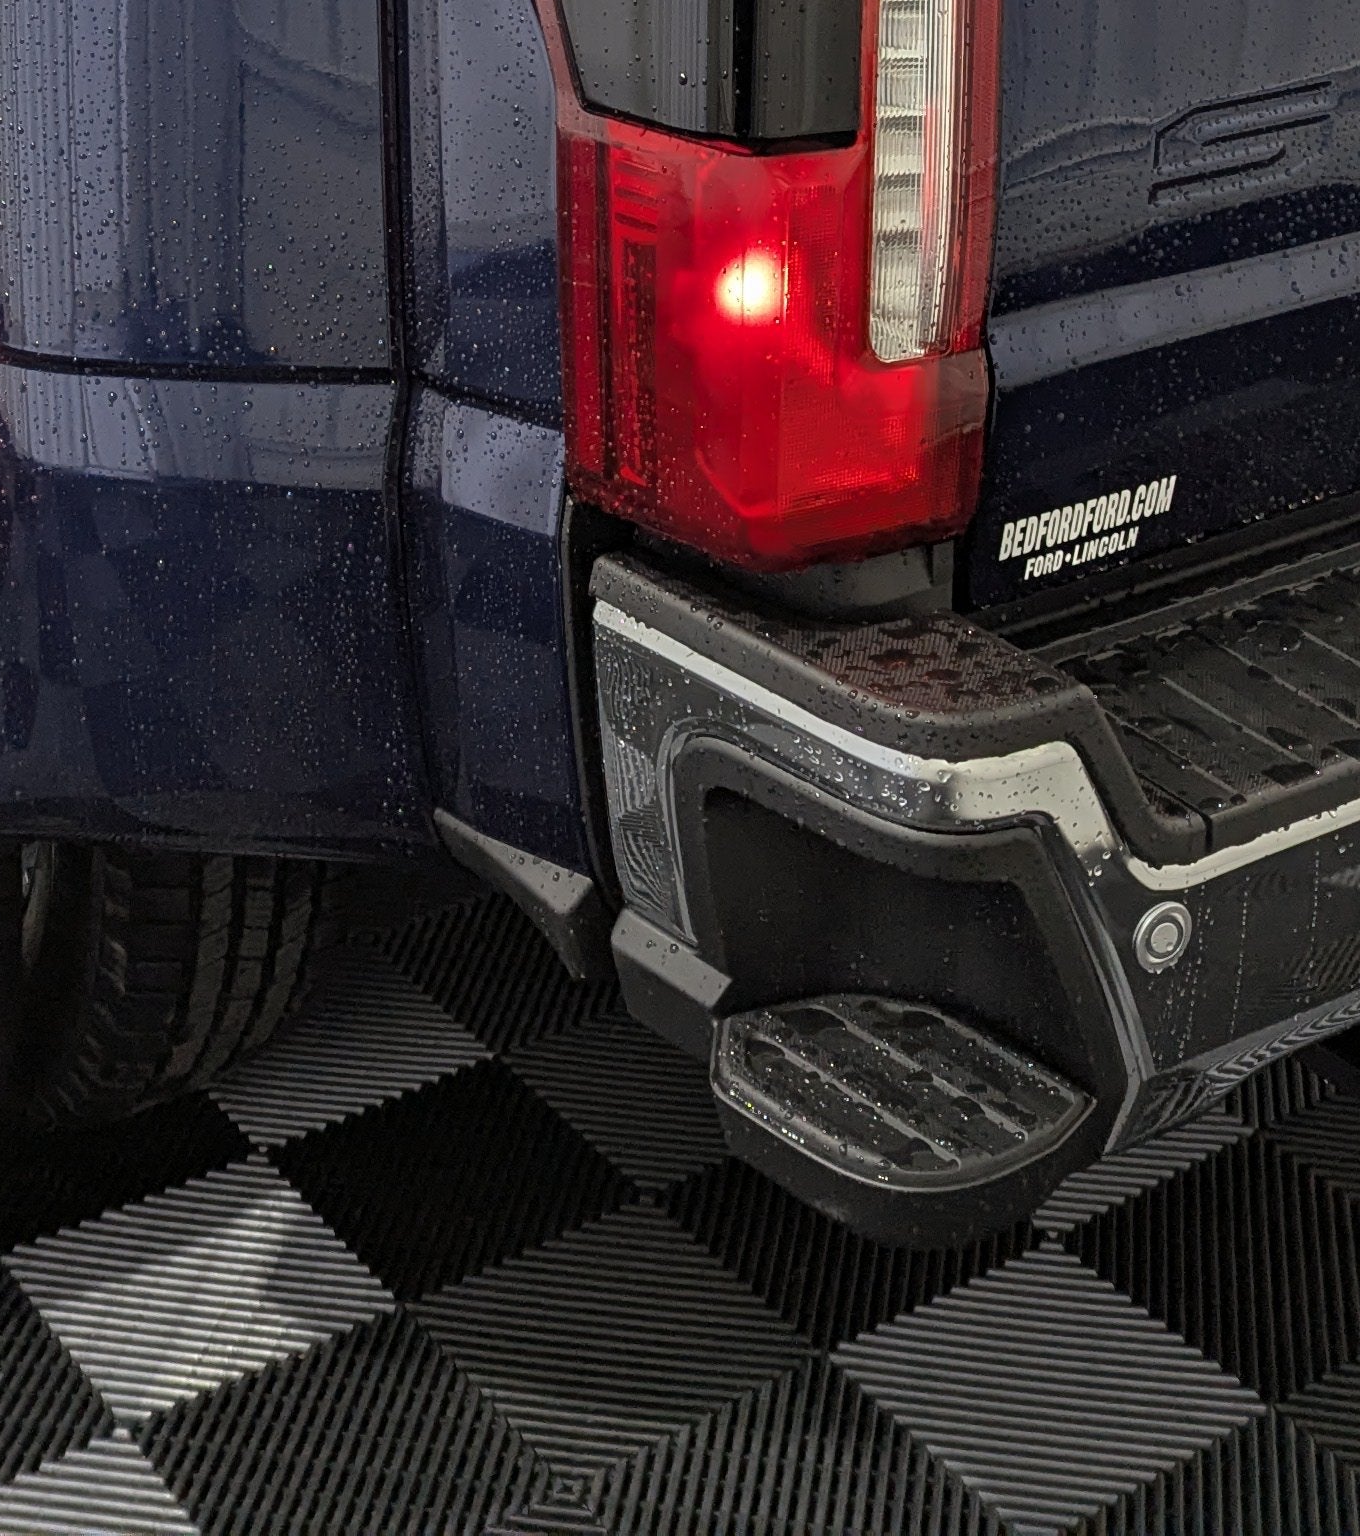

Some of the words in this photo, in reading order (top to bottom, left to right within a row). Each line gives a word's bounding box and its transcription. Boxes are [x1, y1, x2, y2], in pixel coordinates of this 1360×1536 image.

[998, 475, 1177, 562] BEDFORDFORD.COM
[1024, 549, 1064, 581] FORD
[1071, 526, 1139, 566] LINCOLN
